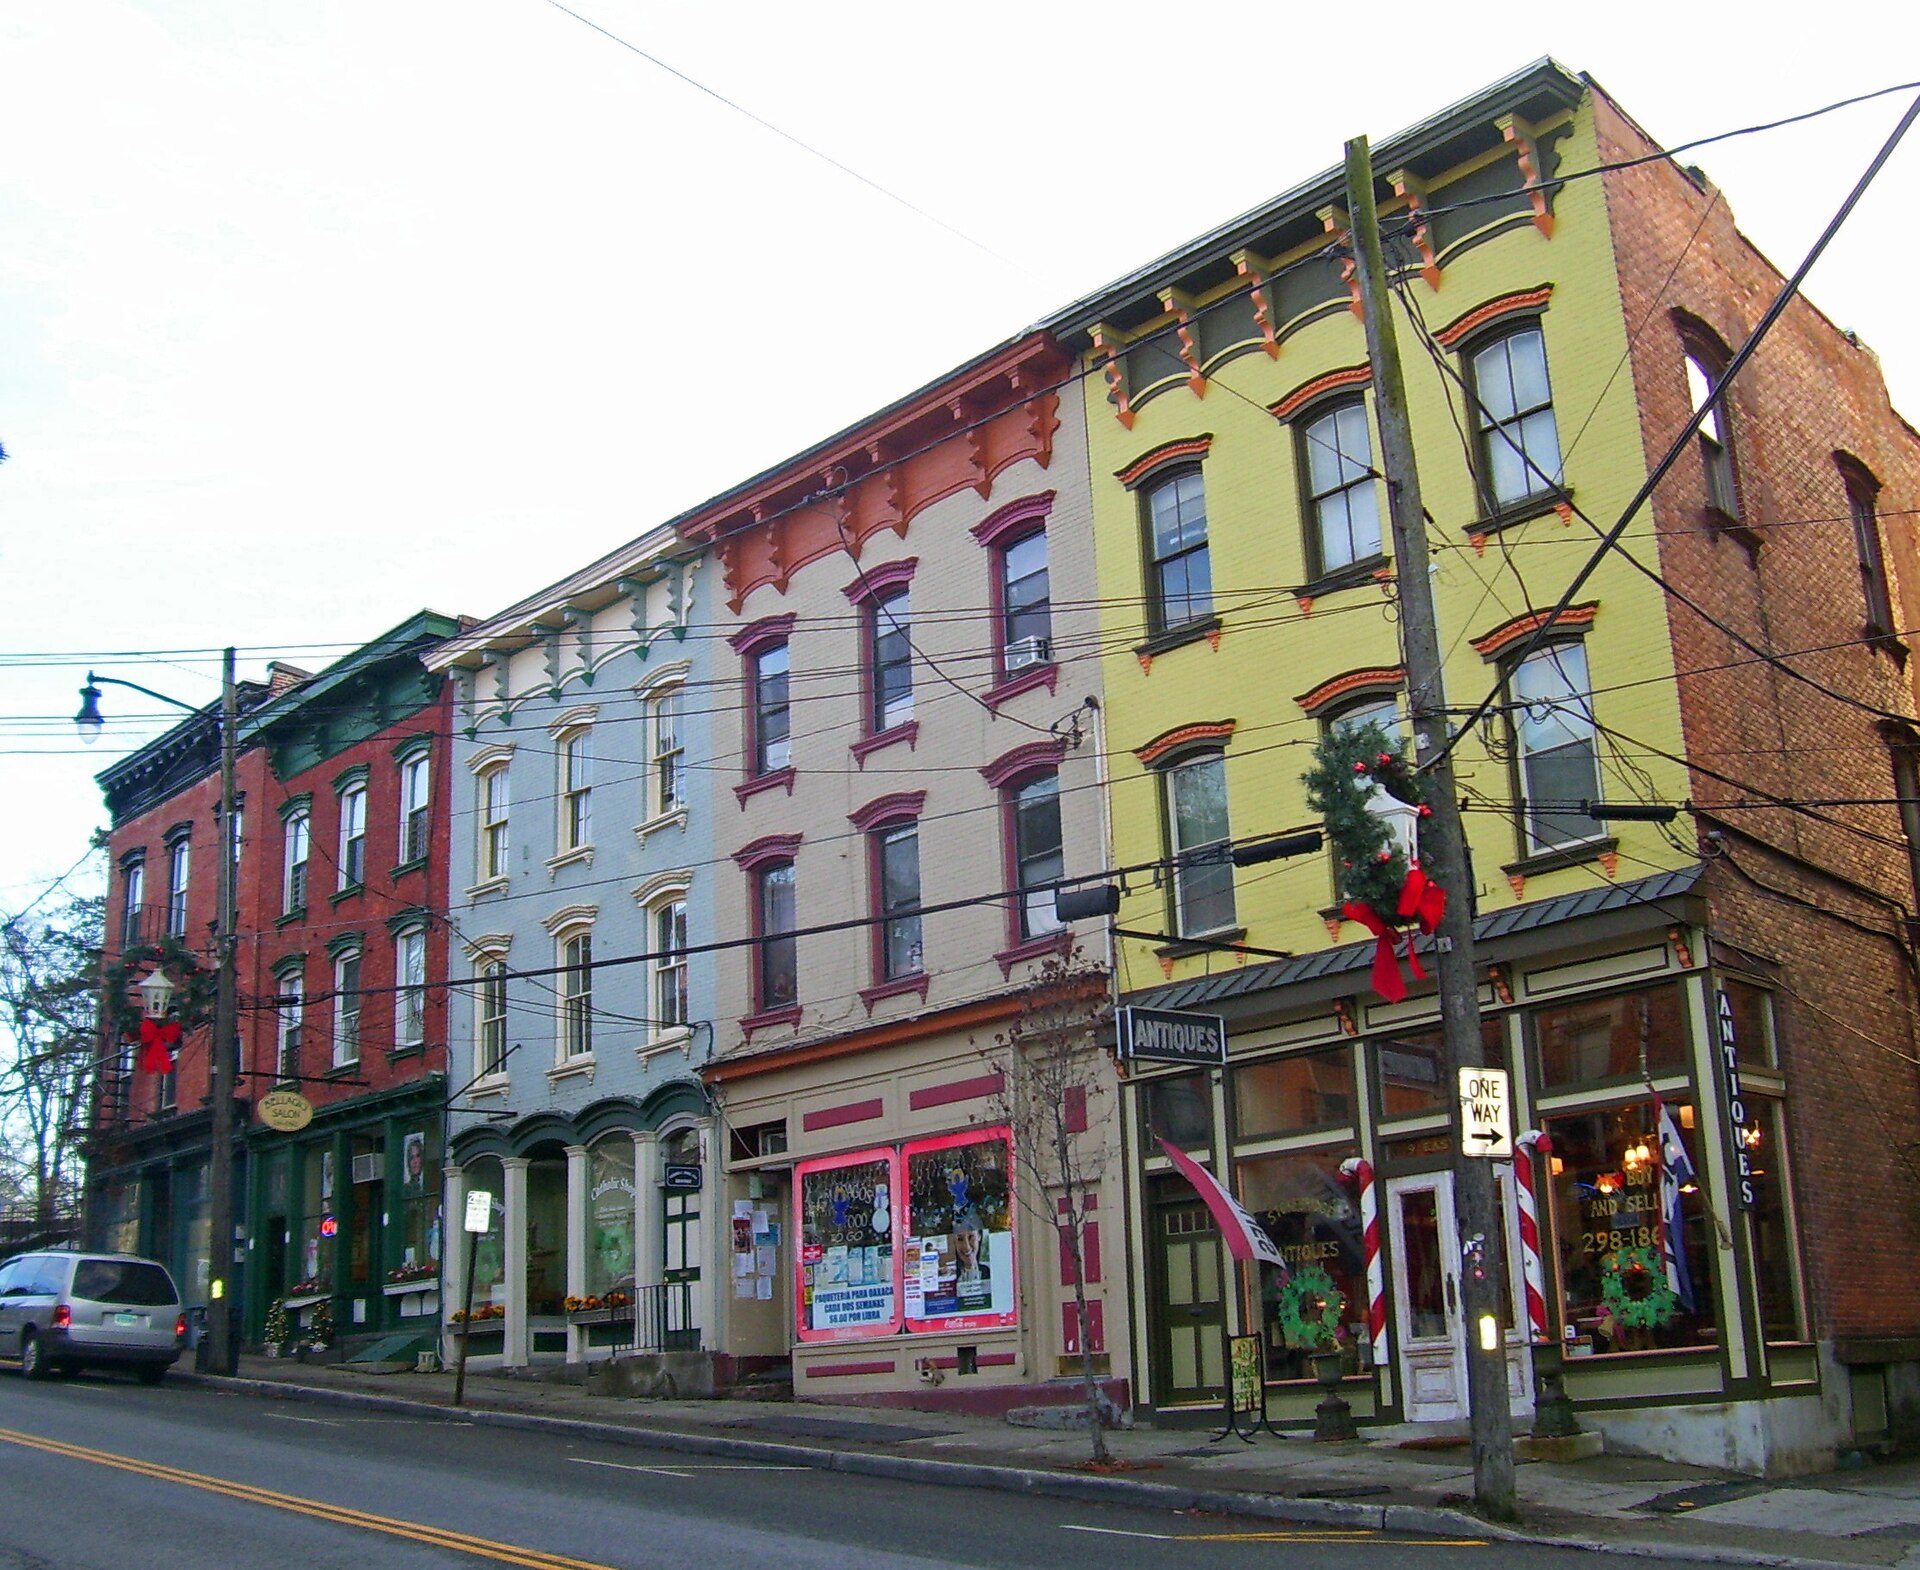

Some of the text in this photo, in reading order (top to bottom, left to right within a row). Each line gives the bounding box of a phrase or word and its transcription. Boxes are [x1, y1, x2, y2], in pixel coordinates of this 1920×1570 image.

[1134, 1019, 1219, 1054] ANTIQUES
[1469, 1079, 1501, 1099] ONE
[1720, 995, 1753, 1204] ANTIQUES
[272, 1108, 301, 1119] SALON
[1471, 1104, 1501, 1122] WAY
[1626, 1166, 1653, 1186] BUY
[1590, 1199, 1618, 1217] AND
[815, 1290, 851, 1303] PAQUETERIA
[852, 1288, 868, 1299] PARA
[869, 1286, 894, 1297] OAXACA
[824, 1299, 885, 1313] CADA DOS SEMANAS
[849, 1311, 861, 1322] POR
[861, 1310, 881, 1321] LIBRA
